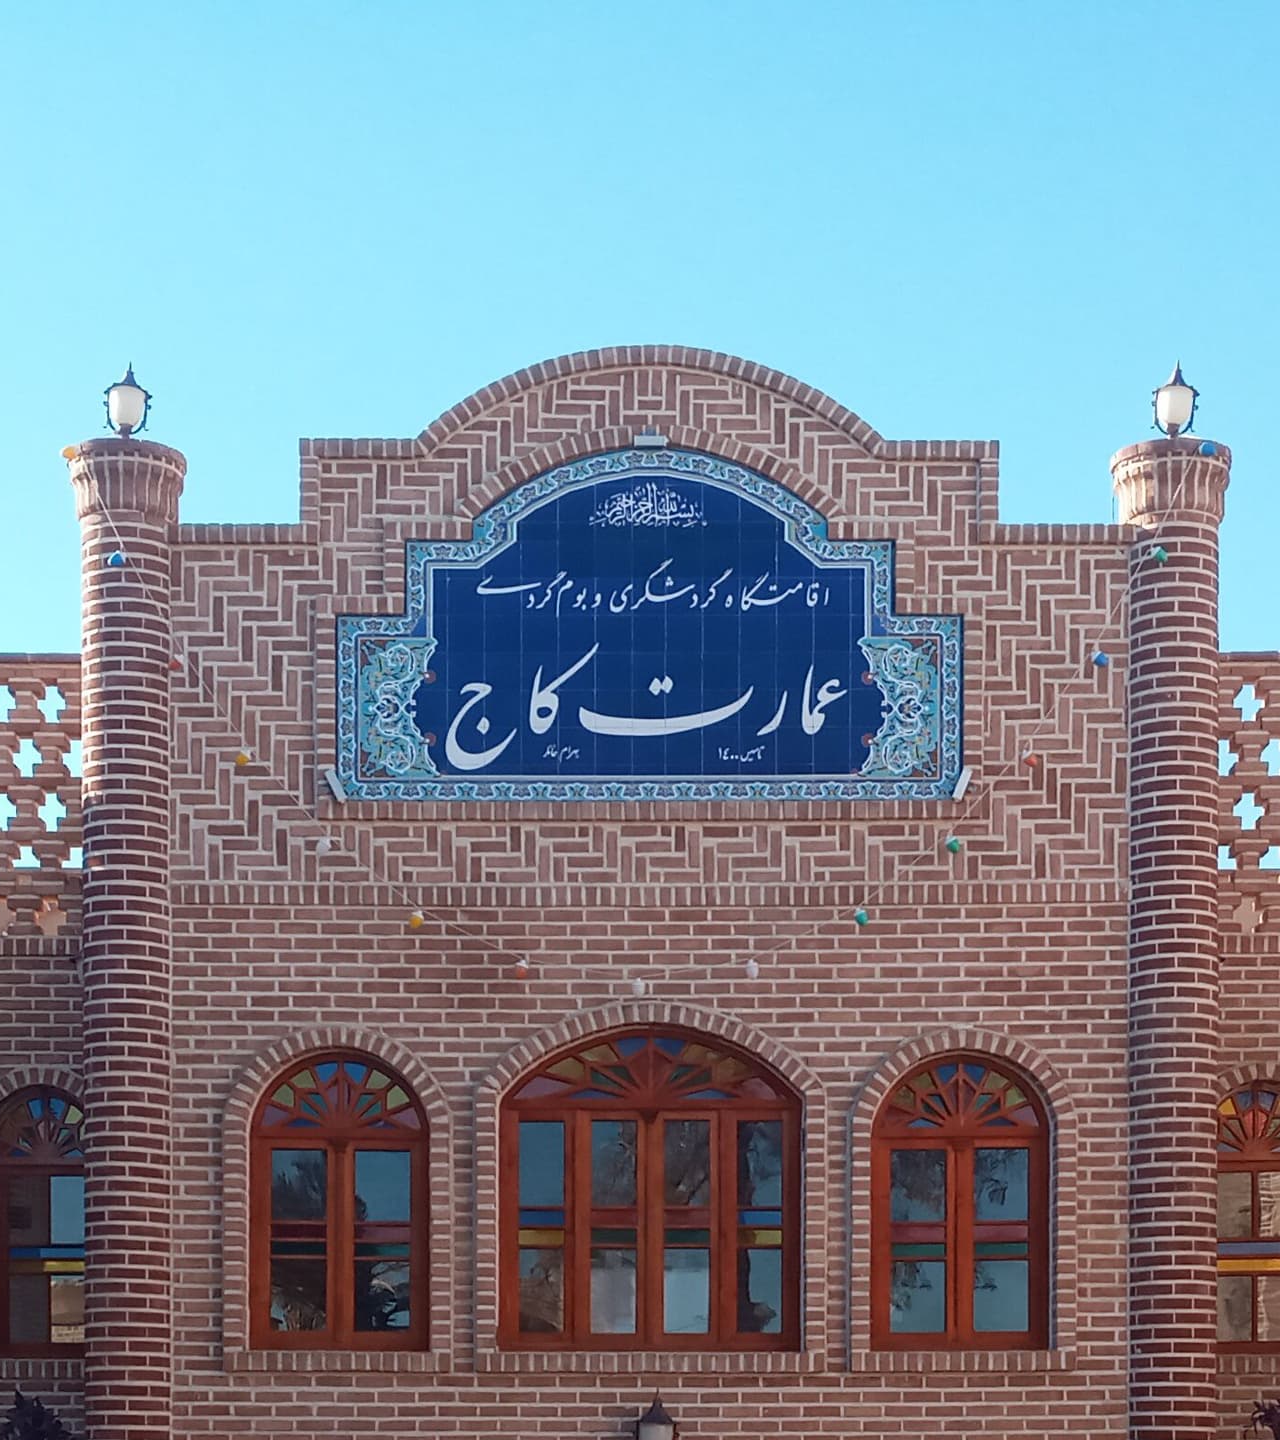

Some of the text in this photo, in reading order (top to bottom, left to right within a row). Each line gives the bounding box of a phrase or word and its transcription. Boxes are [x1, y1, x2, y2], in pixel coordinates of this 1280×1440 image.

[609, 557, 733, 613] گردشگری
[724, 571, 830, 611] اقامتگاه
[445, 642, 848, 771] عمارت کاج
